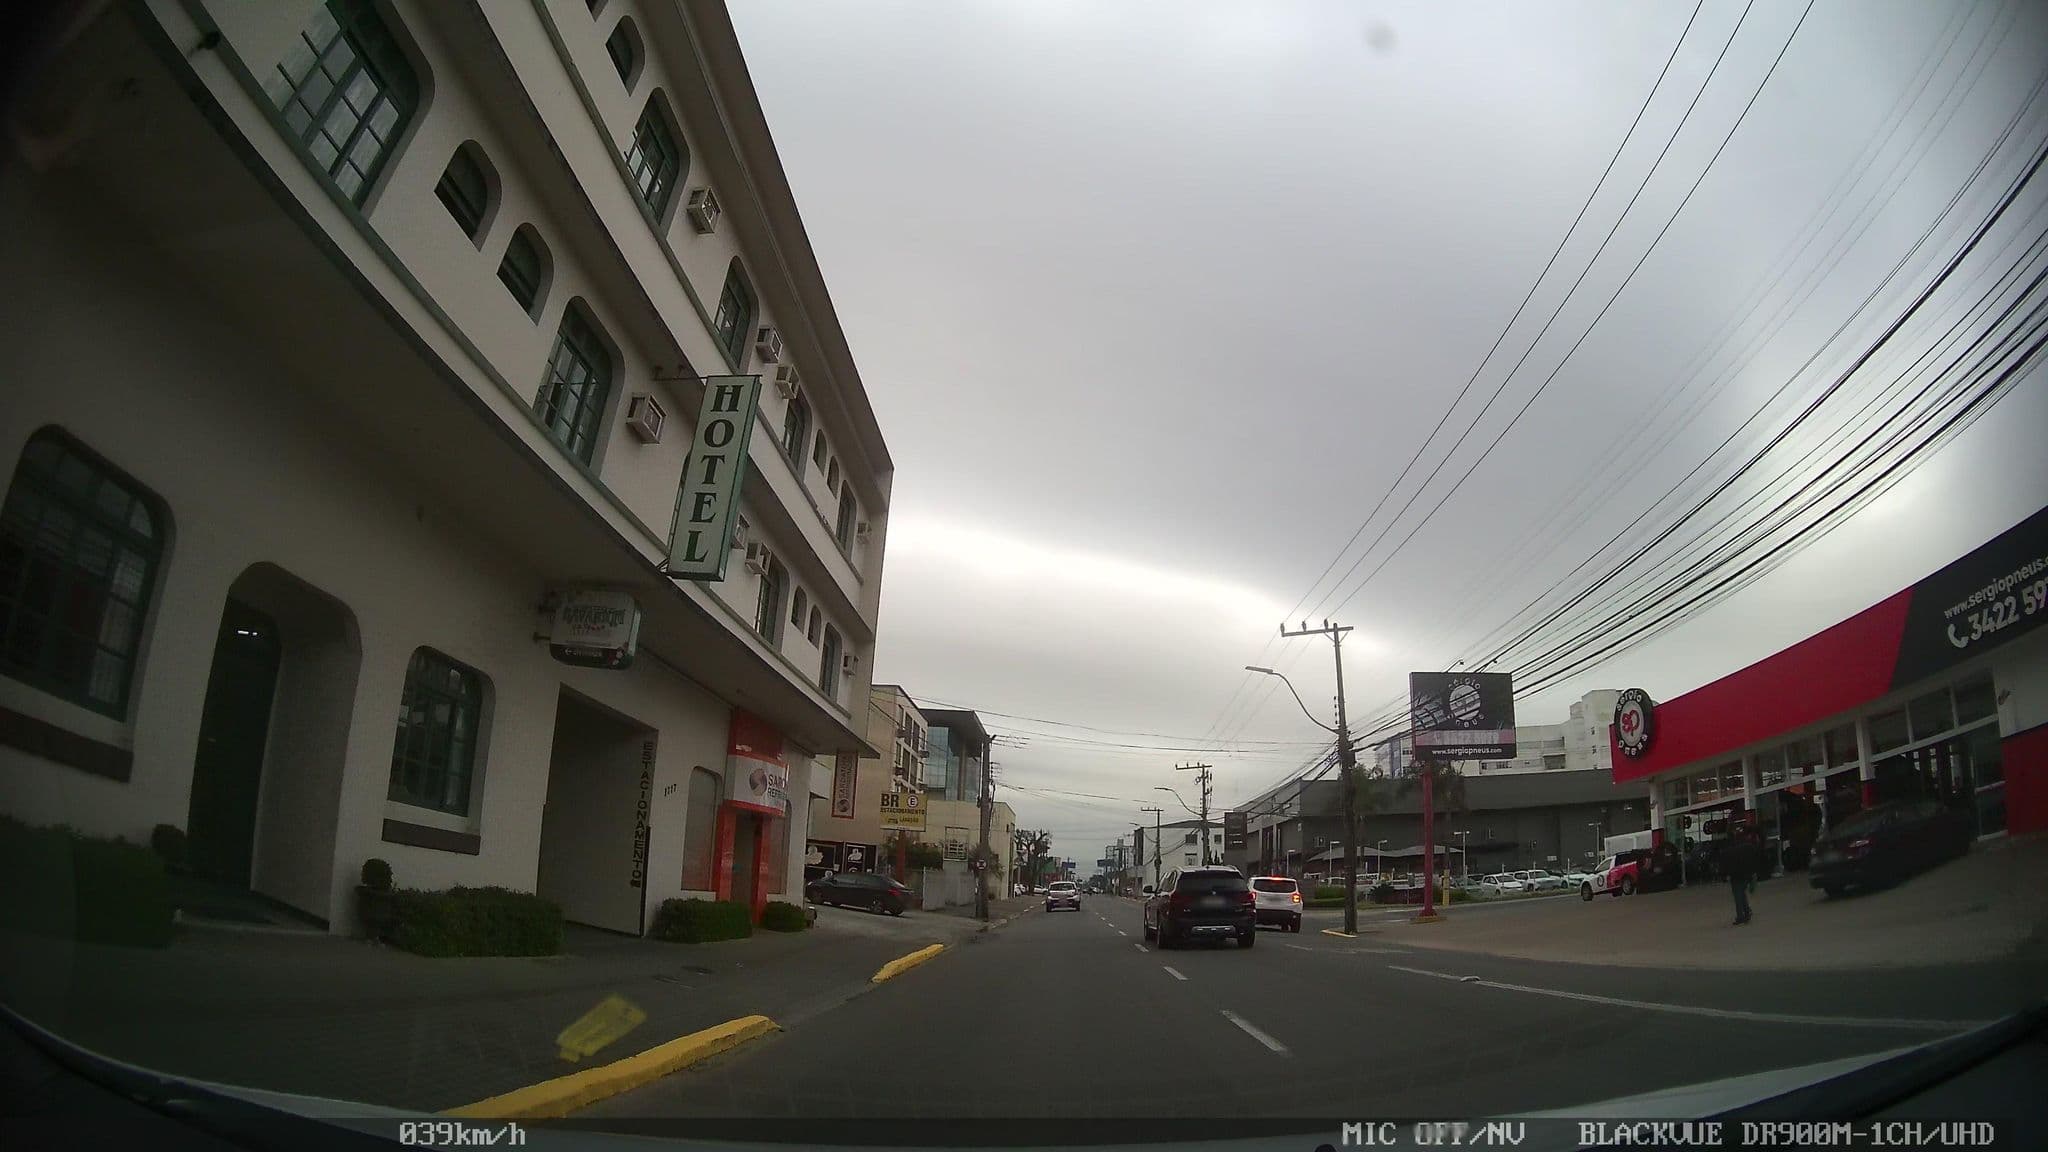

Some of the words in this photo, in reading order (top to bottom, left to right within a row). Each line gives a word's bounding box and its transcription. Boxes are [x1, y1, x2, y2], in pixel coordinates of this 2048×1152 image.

[683, 384, 745, 563] HOTEL
[1968, 596, 2020, 641] 3422
[1431, 746, 1503, 756] www.sergiopneus.com
[632, 742, 654, 879] ESTACIONAMENTO
[880, 793, 899, 808] BR
